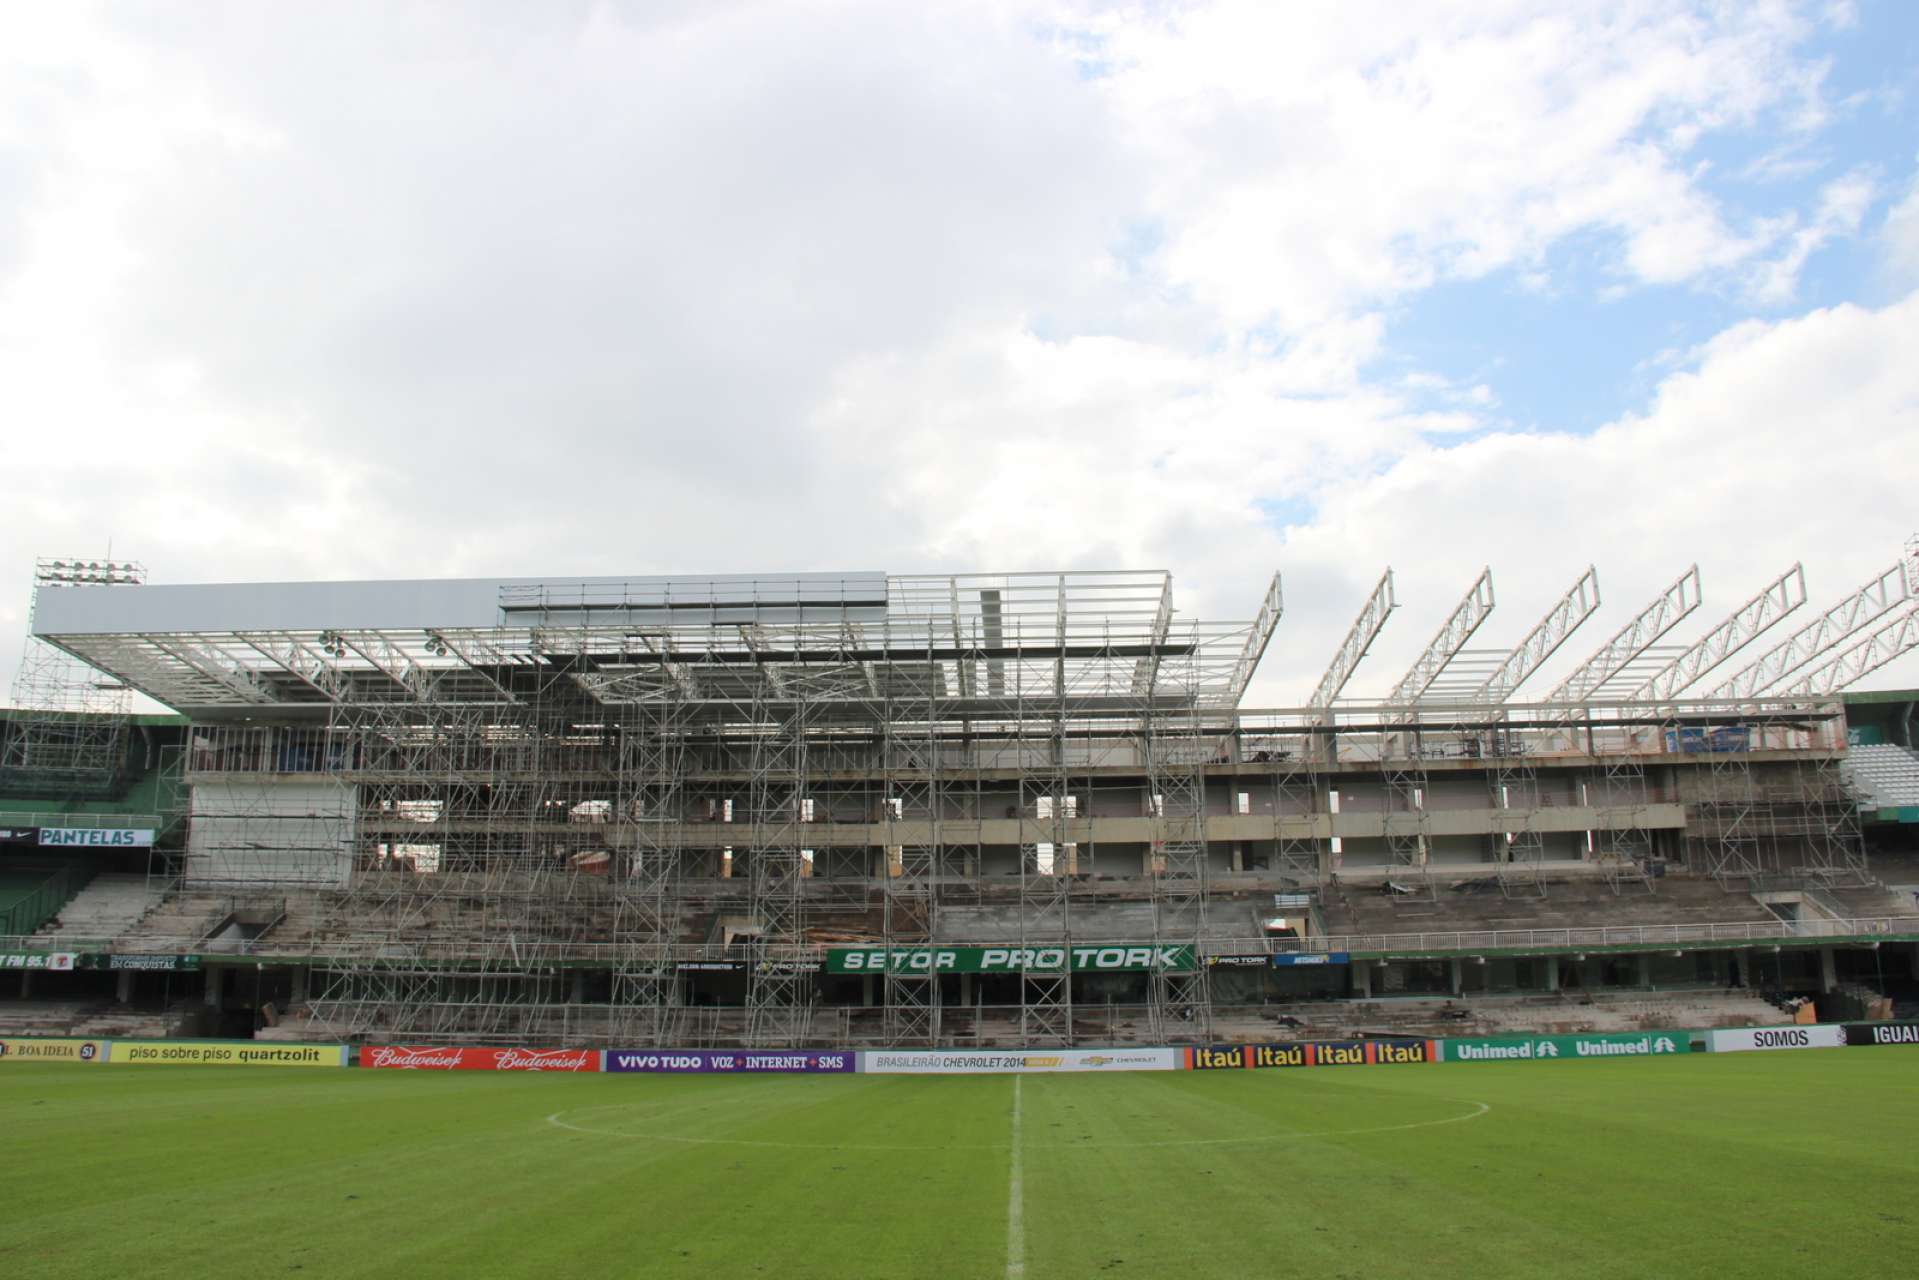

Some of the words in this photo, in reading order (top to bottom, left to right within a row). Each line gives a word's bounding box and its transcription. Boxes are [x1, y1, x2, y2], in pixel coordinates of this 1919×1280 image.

[40, 829, 135, 845] PANTELAS
[6, 955, 26, 967] FM
[123, 960, 176, 969] CONQUISTAS
[843, 952, 957, 969] SETOR
[980, 949, 1066, 969] PRO
[1072, 948, 1180, 968] TORK
[1753, 1030, 1809, 1047] SOMOS
[42, 1045, 75, 1057] IDEIA
[129, 1046, 158, 1060] piso
[161, 1046, 200, 1059] sobre
[203, 1047, 232, 1060] piso
[239, 1048, 320, 1062] quartzolit
[1257, 1046, 1302, 1065] Itaú
[1317, 1044, 1363, 1064] Itaú
[1378, 1043, 1424, 1063] Itaú
[1457, 1042, 1531, 1059] Unimed
[1576, 1039, 1649, 1056] Unimed
[371, 1046, 463, 1069] Budweiser
[494, 1048, 588, 1071] Budweiser
[618, 1055, 659, 1068] VIVO
[661, 1056, 702, 1068] TUDO
[711, 1056, 734, 1069] VOZ
[745, 1056, 808, 1069] INTERNET
[818, 1056, 844, 1068] SMS
[877, 1055, 942, 1067] BRASILEIRÃO
[943, 1057, 1002, 1068] CHEVROLET
[1003, 1057, 1025, 1068] 2014
[1196, 1048, 1242, 1067] Itaú
